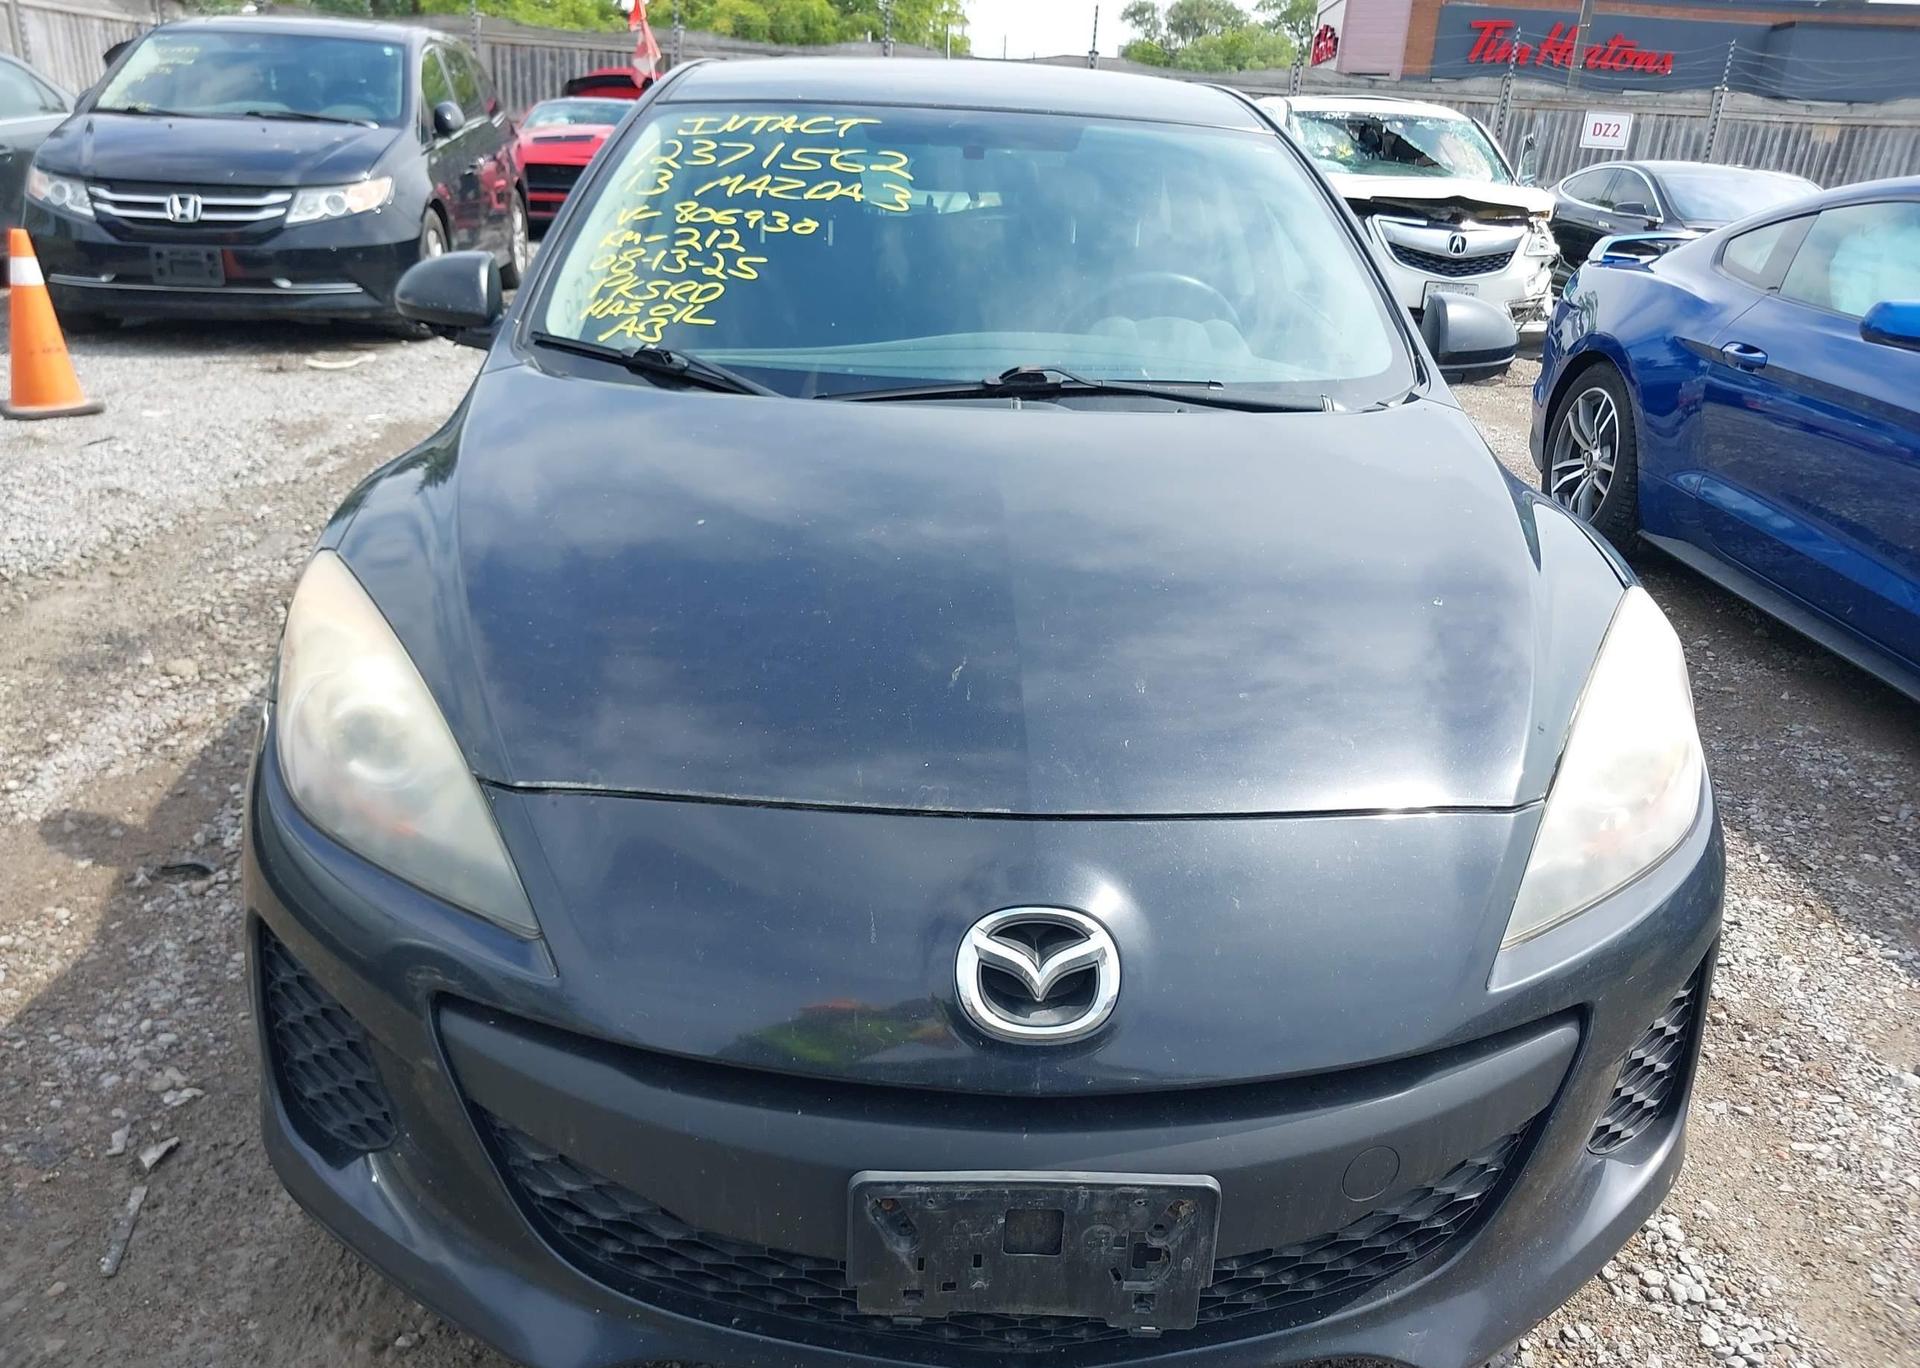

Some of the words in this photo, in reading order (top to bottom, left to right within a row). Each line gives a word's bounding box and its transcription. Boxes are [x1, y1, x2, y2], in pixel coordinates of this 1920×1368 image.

[1467, 19, 1533, 66] Tim
[677, 114, 882, 138] INTACT
[1592, 122, 1621, 138] DZ2
[674, 200, 820, 235] 806930
